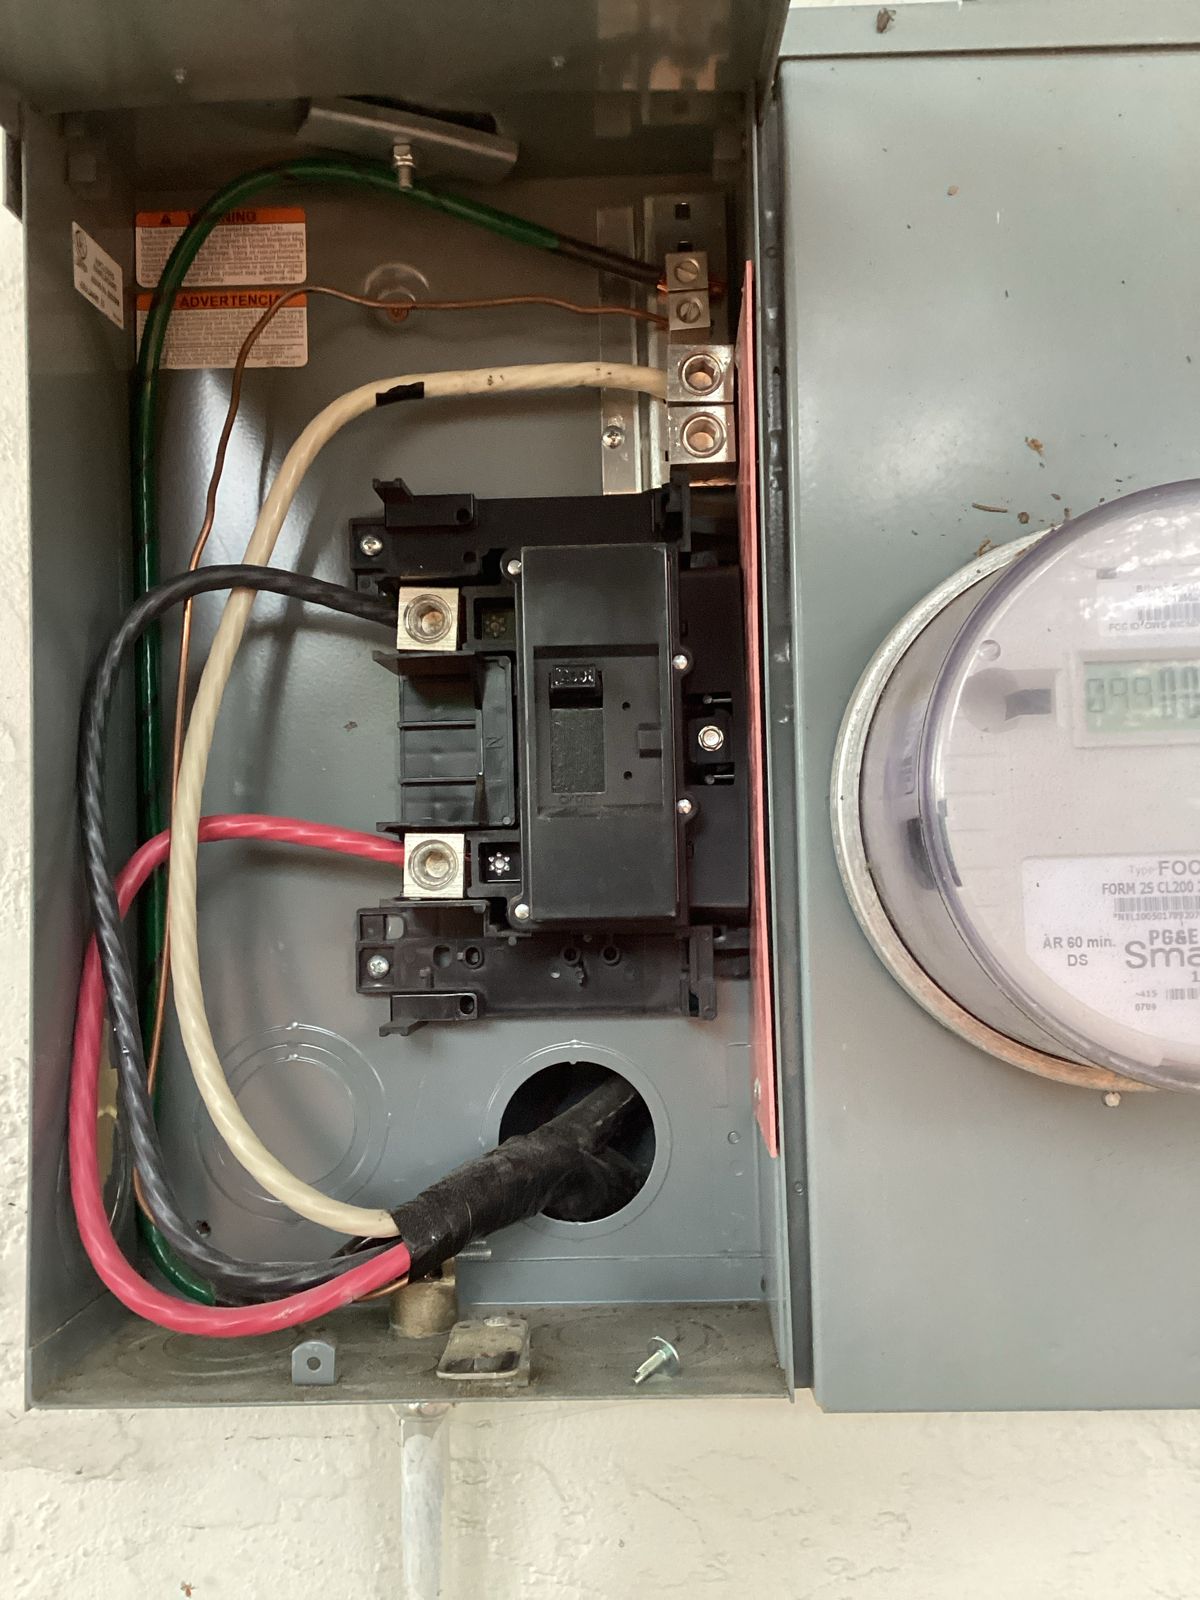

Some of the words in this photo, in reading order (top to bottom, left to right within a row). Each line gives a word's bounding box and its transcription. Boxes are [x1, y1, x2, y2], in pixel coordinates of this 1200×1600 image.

[1102, 882, 1136, 895] FORM
[1140, 881, 1154, 894] 2S
[1157, 880, 1194, 894] CL200
[1067, 936, 1083, 949] 60
[1087, 935, 1116, 948] min.
[1149, 928, 1199, 946] PG&E
[1067, 954, 1089, 967] DS
